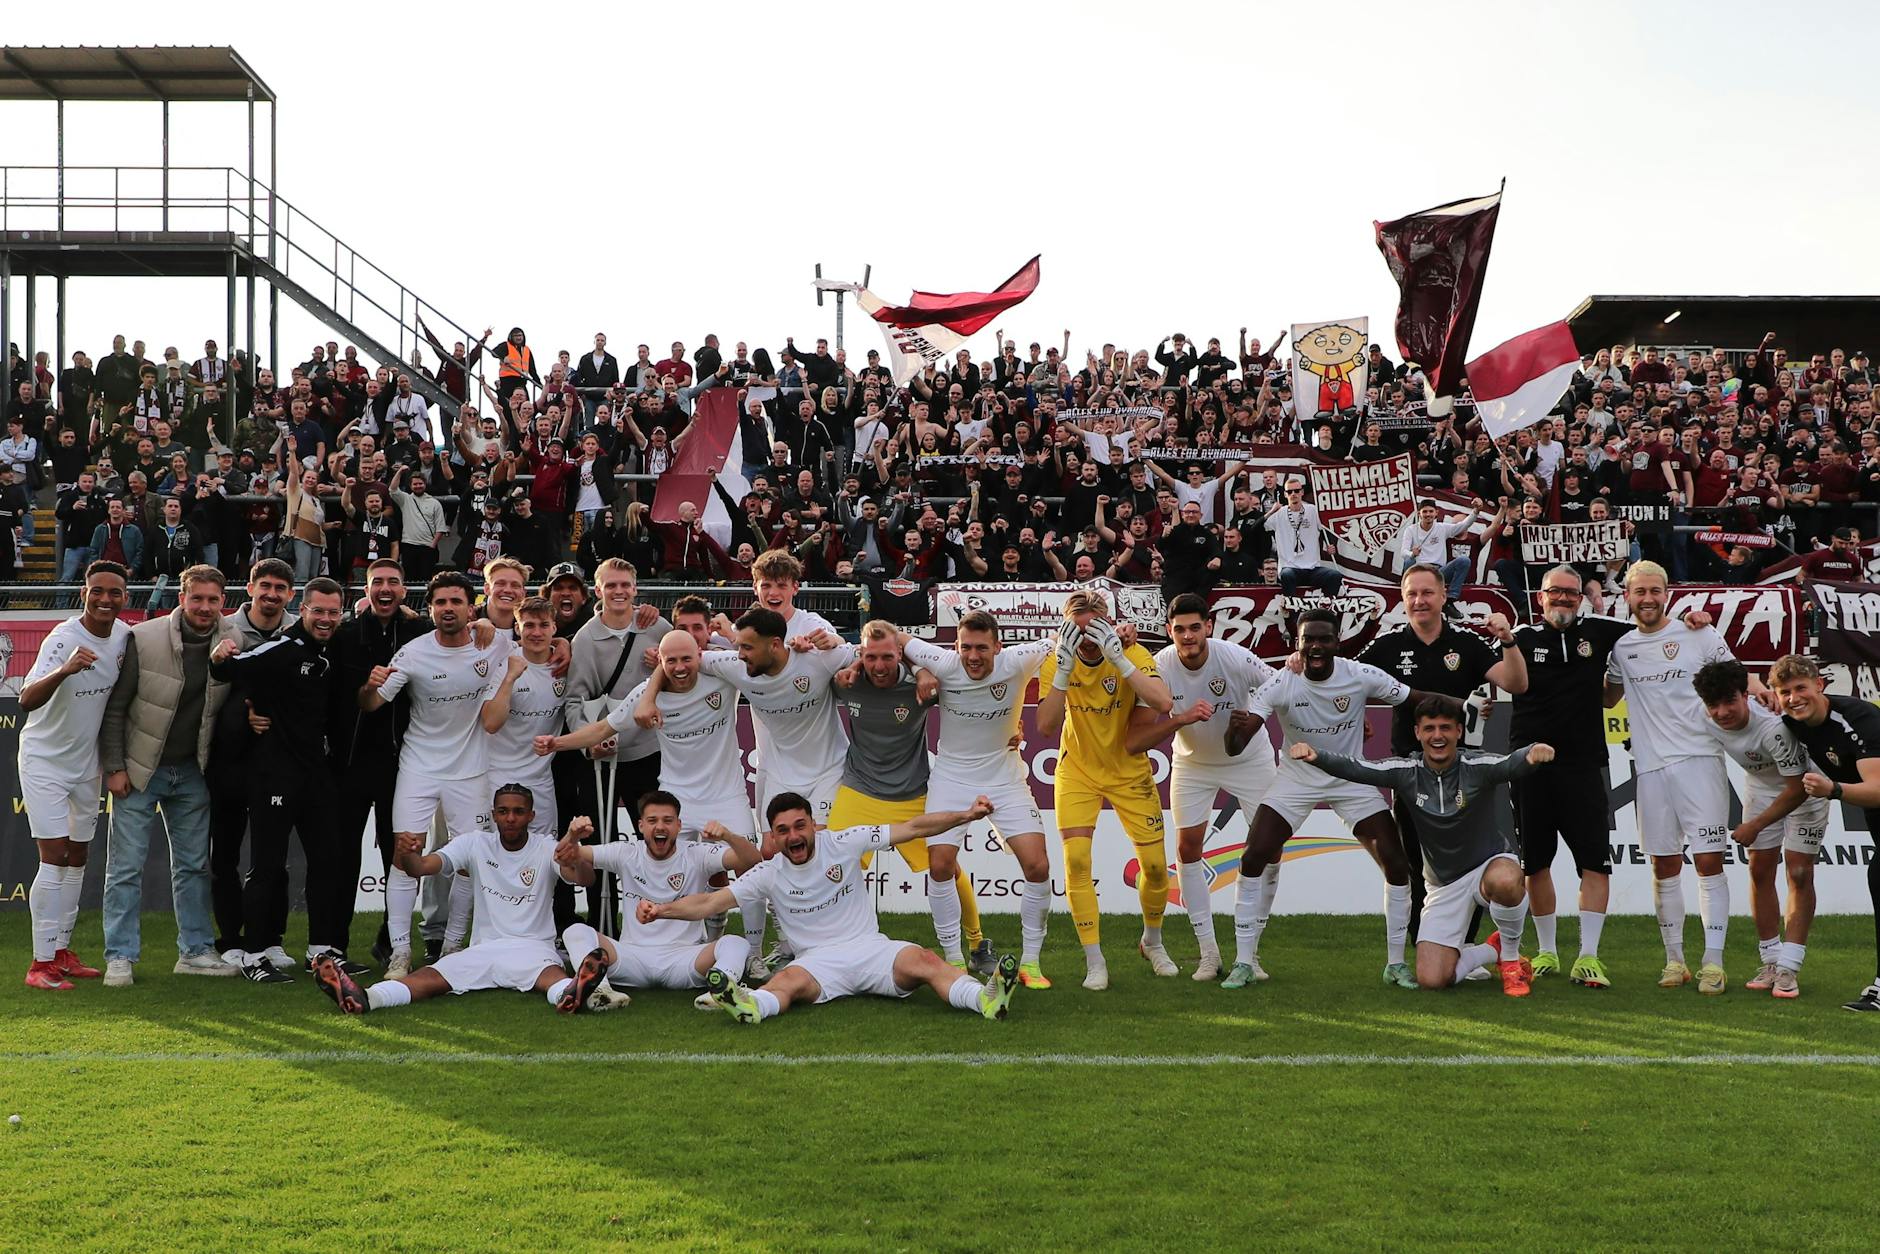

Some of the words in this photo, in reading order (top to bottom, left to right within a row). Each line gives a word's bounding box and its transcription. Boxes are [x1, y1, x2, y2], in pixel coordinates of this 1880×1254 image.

[1150, 447, 1179, 460] ALLES
[1201, 447, 1241, 460] DYNAMO
[1312, 458, 1410, 492] NIEMALS
[1317, 481, 1412, 512] AUFGEBEN
[1366, 512, 1401, 530] BFC
[1659, 505, 1669, 521] H
[1534, 542, 1617, 564] ULTRAS
[271, 795, 283, 806] PK
[1698, 824, 1727, 838] DWB
